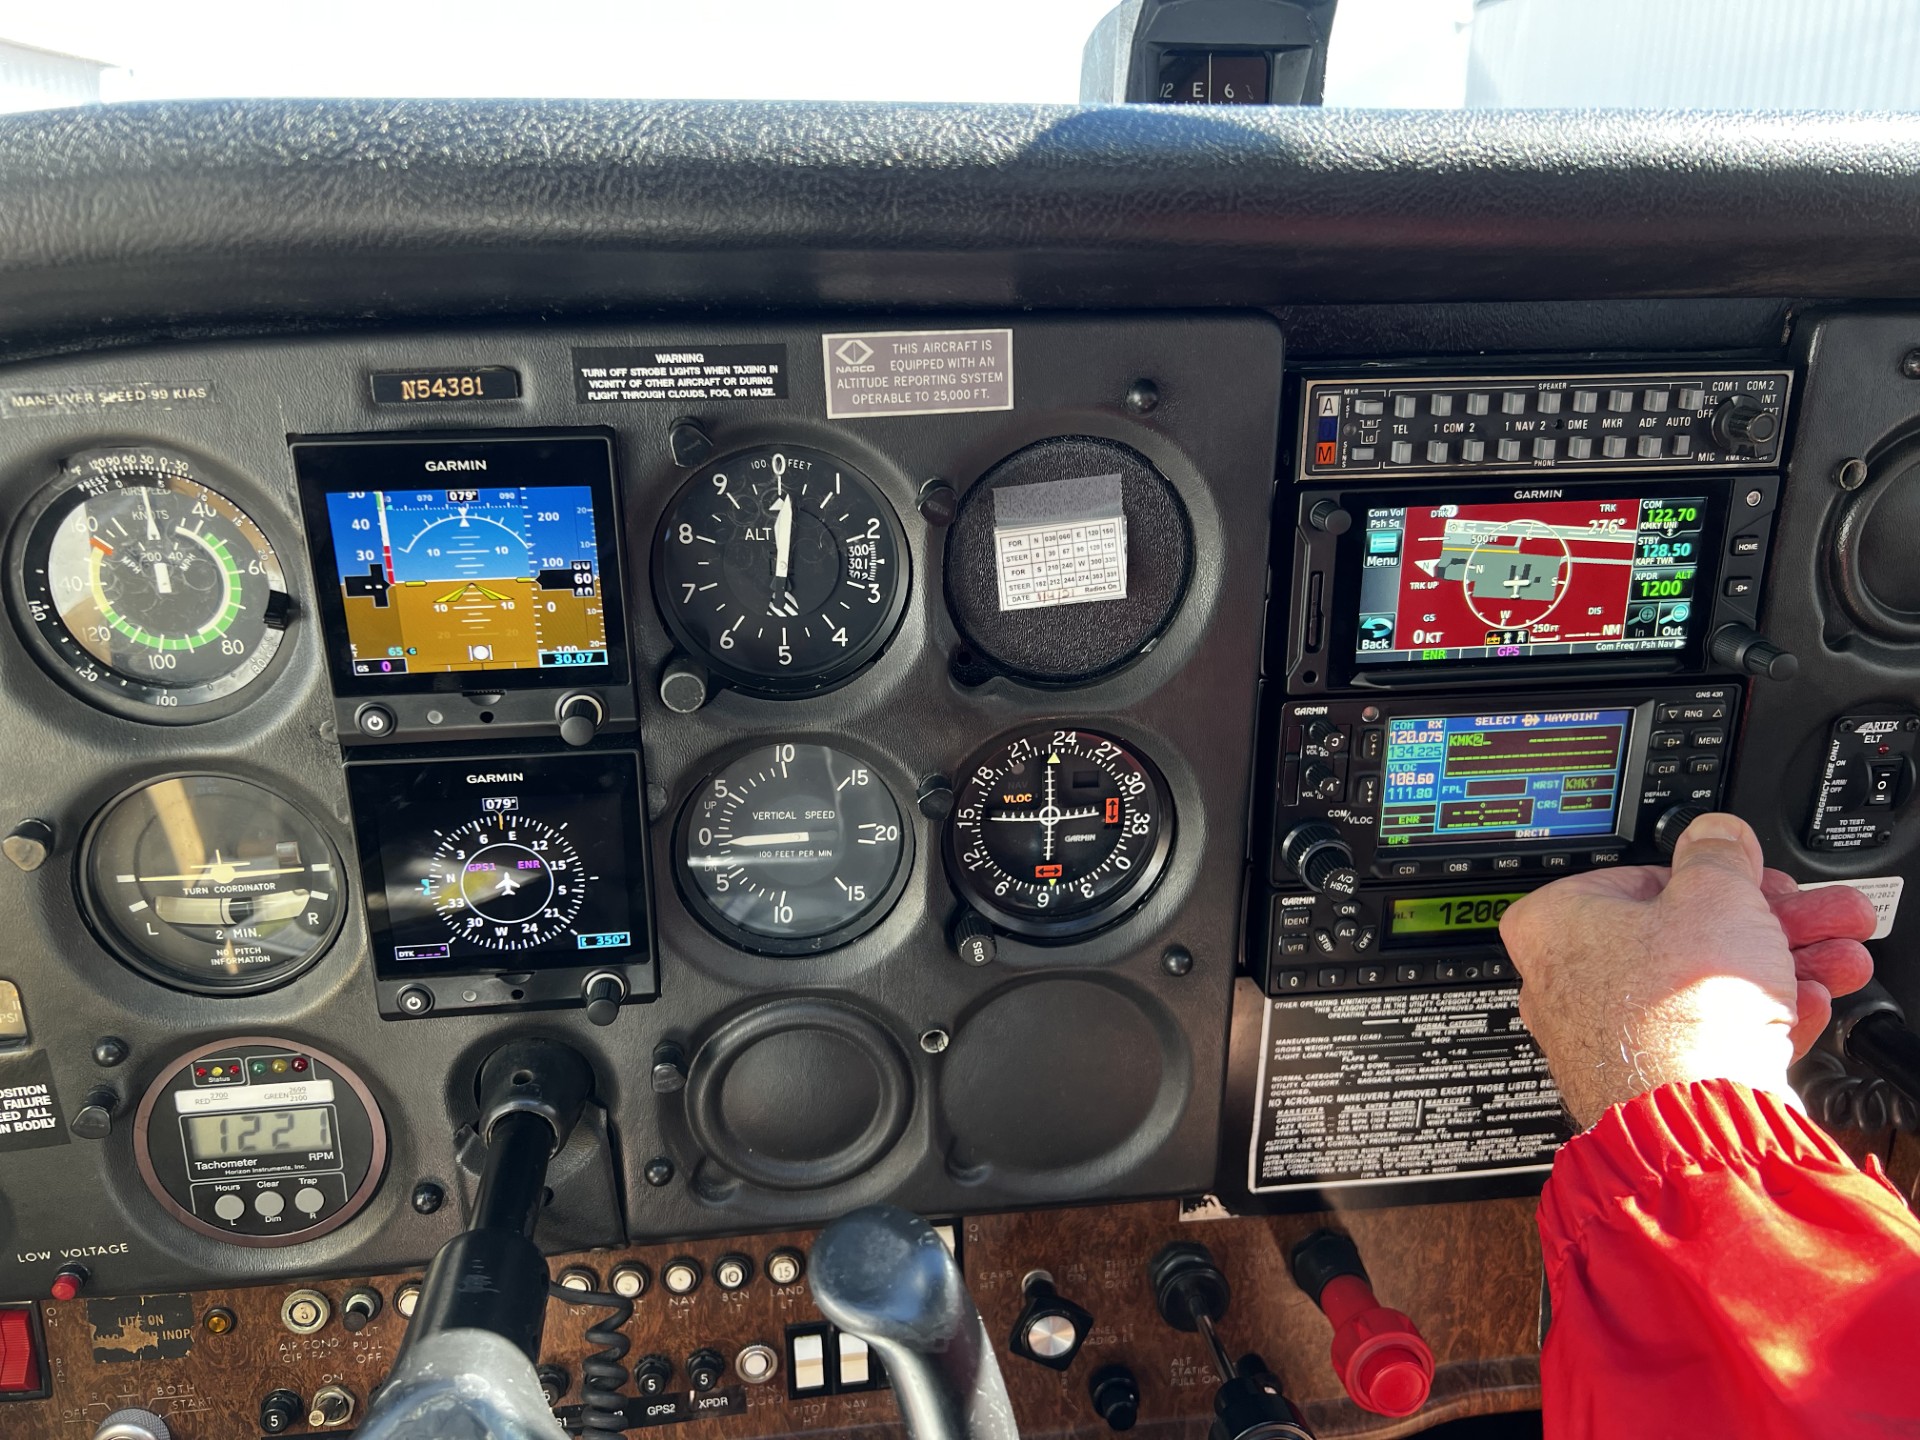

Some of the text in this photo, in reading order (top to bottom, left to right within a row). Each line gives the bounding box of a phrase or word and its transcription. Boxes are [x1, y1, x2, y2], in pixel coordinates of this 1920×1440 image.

[1160, 82, 1234, 98] 12 E 6
[892, 340, 992, 354] THIS AIRCRAFT IS
[656, 354, 704, 364] WARNING
[836, 365, 875, 373] NARCO
[890, 357, 995, 372] EQUIPPED WITH AN
[582, 368, 606, 377] TURN
[610, 368, 627, 376] OFF
[631, 368, 666, 376] STROBE
[670, 367, 700, 375] LIGHTS
[703, 366, 730, 375] WHEN
[770, 365, 778, 373] IN
[589, 376, 773, 389] VICINITY OF OTHER AIRCRAFT OR DURING
[837, 372, 1003, 389] ALTITUDE REPORTING SYSTEM
[401, 377, 483, 399] N54381
[1712, 381, 1774, 391] COM 1 COM 2
[173, 388, 207, 399] KIAS
[588, 391, 618, 400] FLIGHT
[622, 390, 665, 399] THROUGH
[668, 389, 707, 398] CLOUDS,
[734, 388, 747, 397] OR
[750, 388, 776, 396] HAZE.
[852, 393, 911, 405] OPERABLE
[915, 392, 929, 402] TO
[934, 390, 970, 402] 25,000
[1762, 394, 1777, 403] INT
[1697, 410, 1714, 419] OFF
[1505, 421, 1546, 431] 1 NAV 2
[1568, 419, 1589, 430] DME
[1602, 419, 1623, 428] MKR
[1639, 418, 1657, 428] ADF
[1666, 417, 1691, 427] AUTO
[1393, 425, 1408, 435] TEL
[1433, 423, 1475, 433] 1 COM 2
[1698, 453, 1715, 462] MIC
[425, 460, 487, 472] GARMIN
[1514, 489, 1563, 500] GARMIN
[1600, 503, 1616, 512] TRK
[1643, 500, 1662, 509] COM
[537, 512, 559, 521] 200
[1368, 508, 1404, 518] Com Vol
[1647, 507, 1696, 523] 122.70
[352, 519, 370, 530] 40
[1588, 518, 1627, 535] 276°
[744, 528, 771, 541] ALT
[1638, 536, 1659, 545] STBY
[1642, 543, 1691, 558] 128.50
[1738, 543, 1758, 551] HOME
[356, 550, 374, 561] 30
[1006, 554, 1028, 562] STEER
[542, 558, 563, 567] 100
[1367, 556, 1398, 566] Menu
[1635, 572, 1658, 580] XPDR
[1675, 570, 1693, 579] ALT
[1009, 582, 1031, 591] STEER
[1085, 585, 1106, 593] Radios
[1641, 580, 1681, 597] 1200
[1662, 626, 1682, 636] Out
[1362, 640, 1390, 649] Back
[1596, 640, 1674, 652] Com Freq Psh Nav
[1423, 650, 1446, 660] ENR
[1497, 646, 1520, 657] GPS
[149, 654, 176, 670] 100
[554, 653, 593, 664] 30.07
[1294, 707, 1328, 715] GARMIN
[1475, 716, 1517, 726] SELECT
[1544, 712, 1599, 722] WAYPOINT
[1389, 731, 1443, 744] 120.075
[1698, 736, 1723, 744] MENU
[1864, 735, 1882, 743] ELT
[1389, 763, 1417, 771] VLOC
[466, 772, 524, 784] GARMIN
[1389, 773, 1434, 785] 108.60
[1813, 739, 1840, 829] EMERGENCY USE ONLY
[1003, 793, 1032, 803] VLOC
[1387, 788, 1433, 799] 111.80
[1692, 790, 1711, 798] GPS
[752, 810, 835, 820] VERTICAL SPEED
[1064, 834, 1096, 842] GARMIN
[1595, 854, 1619, 862] PROC
[468, 860, 541, 872] GPS1 ENR
[1450, 863, 1468, 872] OBS
[1499, 859, 1518, 868] MSG
[183, 883, 276, 895] TURN COORDINATOR
[1282, 896, 1315, 906] GARMIN
[1284, 916, 1309, 926] IDENT
[1339, 928, 1355, 937] ALT
[216, 946, 261, 956] NO PITCH
[211, 955, 270, 966] INFORMATION
[3, 1095, 52, 1110] FAILURE
[27, 1108, 52, 1118] ALL
[15, 1118, 56, 1132] BODILY
[220, 1111, 328, 1153] 1221
[308, 1152, 334, 1162] RPM
[195, 1158, 258, 1171] Tachometer
[256, 1180, 280, 1188] Clear
[298, 1177, 317, 1186] Trap
[215, 1184, 241, 1192] Hours
[265, 1215, 282, 1223] Dim
[17, 1243, 129, 1263] LOW VOLTAGE
[770, 1286, 804, 1296] LAND
[669, 1297, 696, 1306] NAV
[148, 1314, 164, 1325] ON
[698, 1397, 728, 1408] XPDR
[647, 1404, 676, 1416] GPS2
